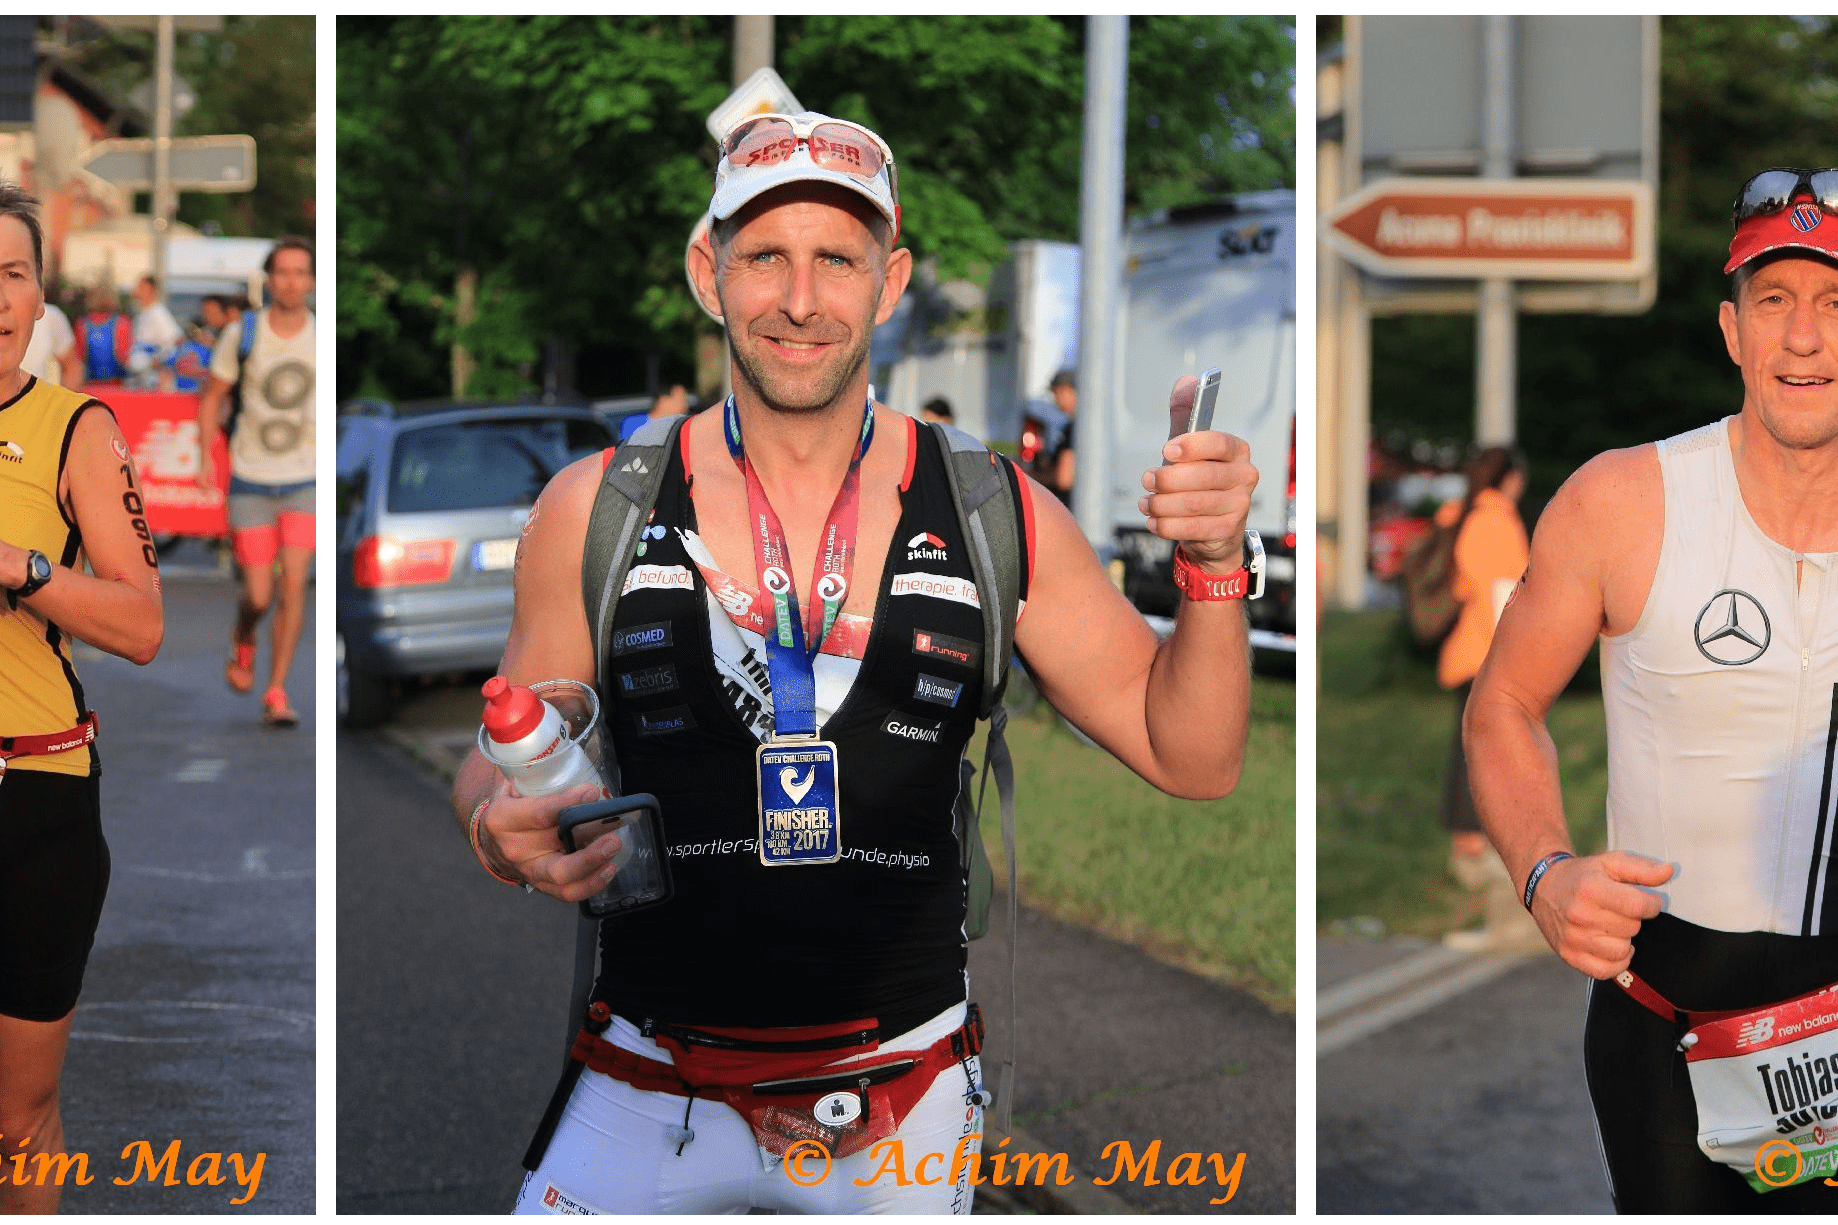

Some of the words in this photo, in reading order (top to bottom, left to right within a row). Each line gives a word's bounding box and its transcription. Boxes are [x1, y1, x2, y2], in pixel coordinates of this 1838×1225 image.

[823, 523, 837, 572] CHALLENGE
[907, 548, 948, 561] skinfit
[638, 569, 690, 585] befund.
[894, 578, 957, 596] therapie.
[962, 583, 979, 602] tra
[774, 596, 791, 640] DATEV
[625, 628, 665, 647] COSMED
[930, 646, 969, 662] running
[886, 721, 938, 743] GARMIN
[793, 829, 829, 851] 2017
[1777, 1021, 1802, 1038] new
